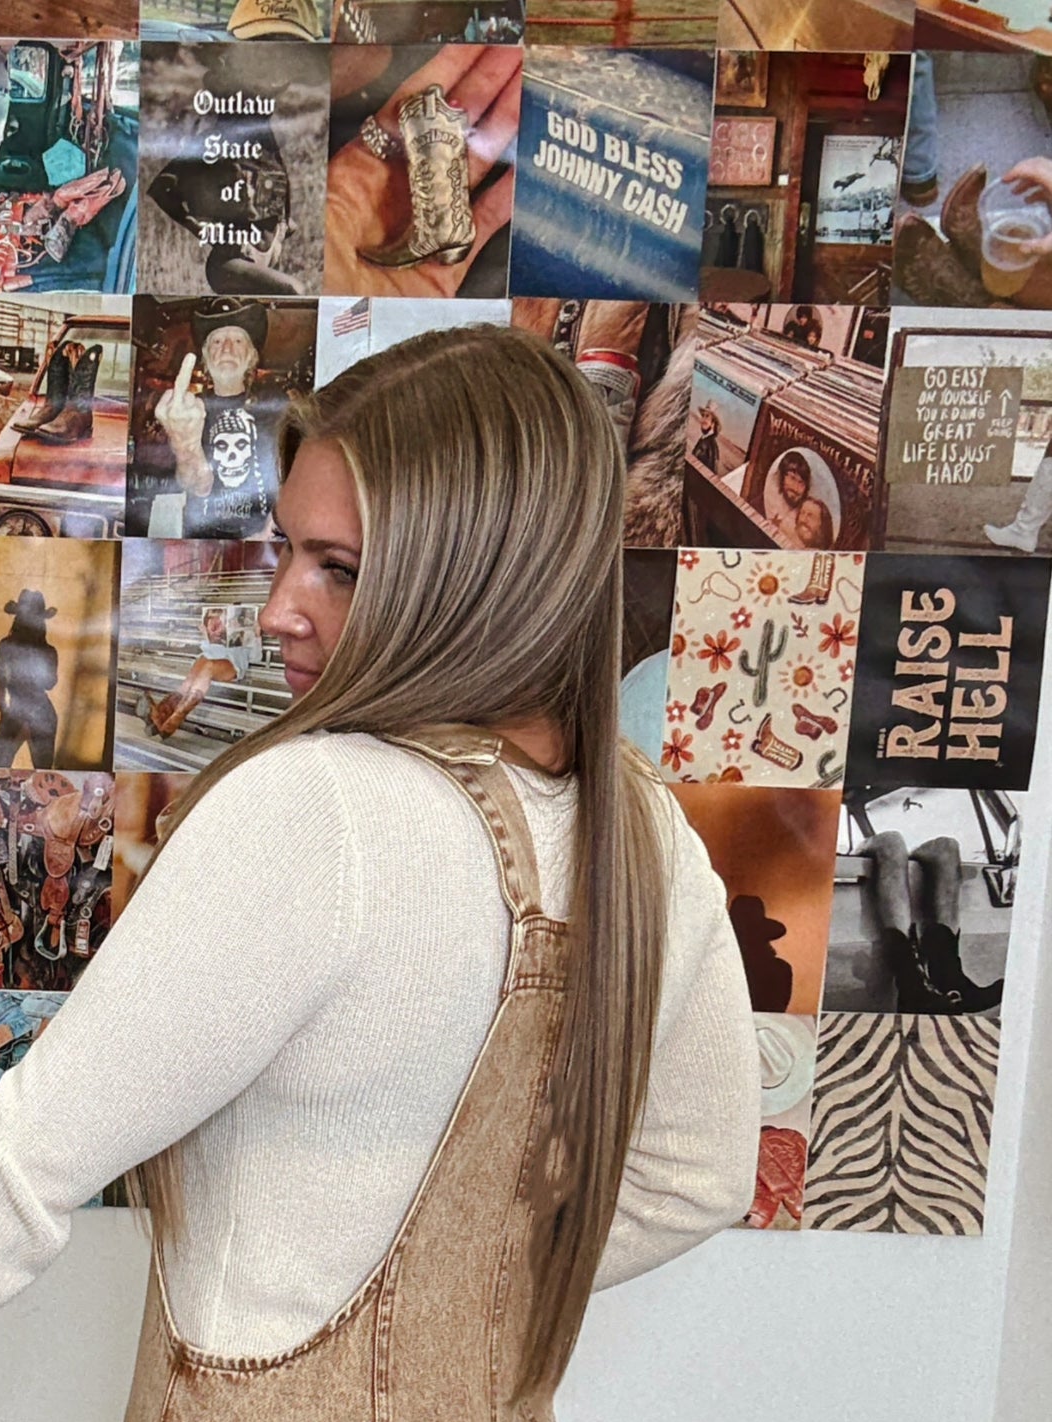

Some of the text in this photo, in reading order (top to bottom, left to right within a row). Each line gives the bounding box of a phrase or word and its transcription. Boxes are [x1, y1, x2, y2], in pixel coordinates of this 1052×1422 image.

[193, 89, 276, 115] Outlaw
[202, 133, 263, 164] State
[547, 111, 684, 190] GOD BLESS
[220, 179, 245, 202] of
[533, 140, 689, 234] JOHNNY CASH
[198, 220, 262, 248] Mind
[924, 367, 987, 389] GO EASY
[940, 389, 992, 406] YOURSELF
[923, 423, 975, 442] GREAT
[903, 441, 996, 464] LIFE IS JUST
[926, 463, 974, 485] HARD
[886, 587, 956, 759] RAISE
[946, 616, 1013, 761] HELL
